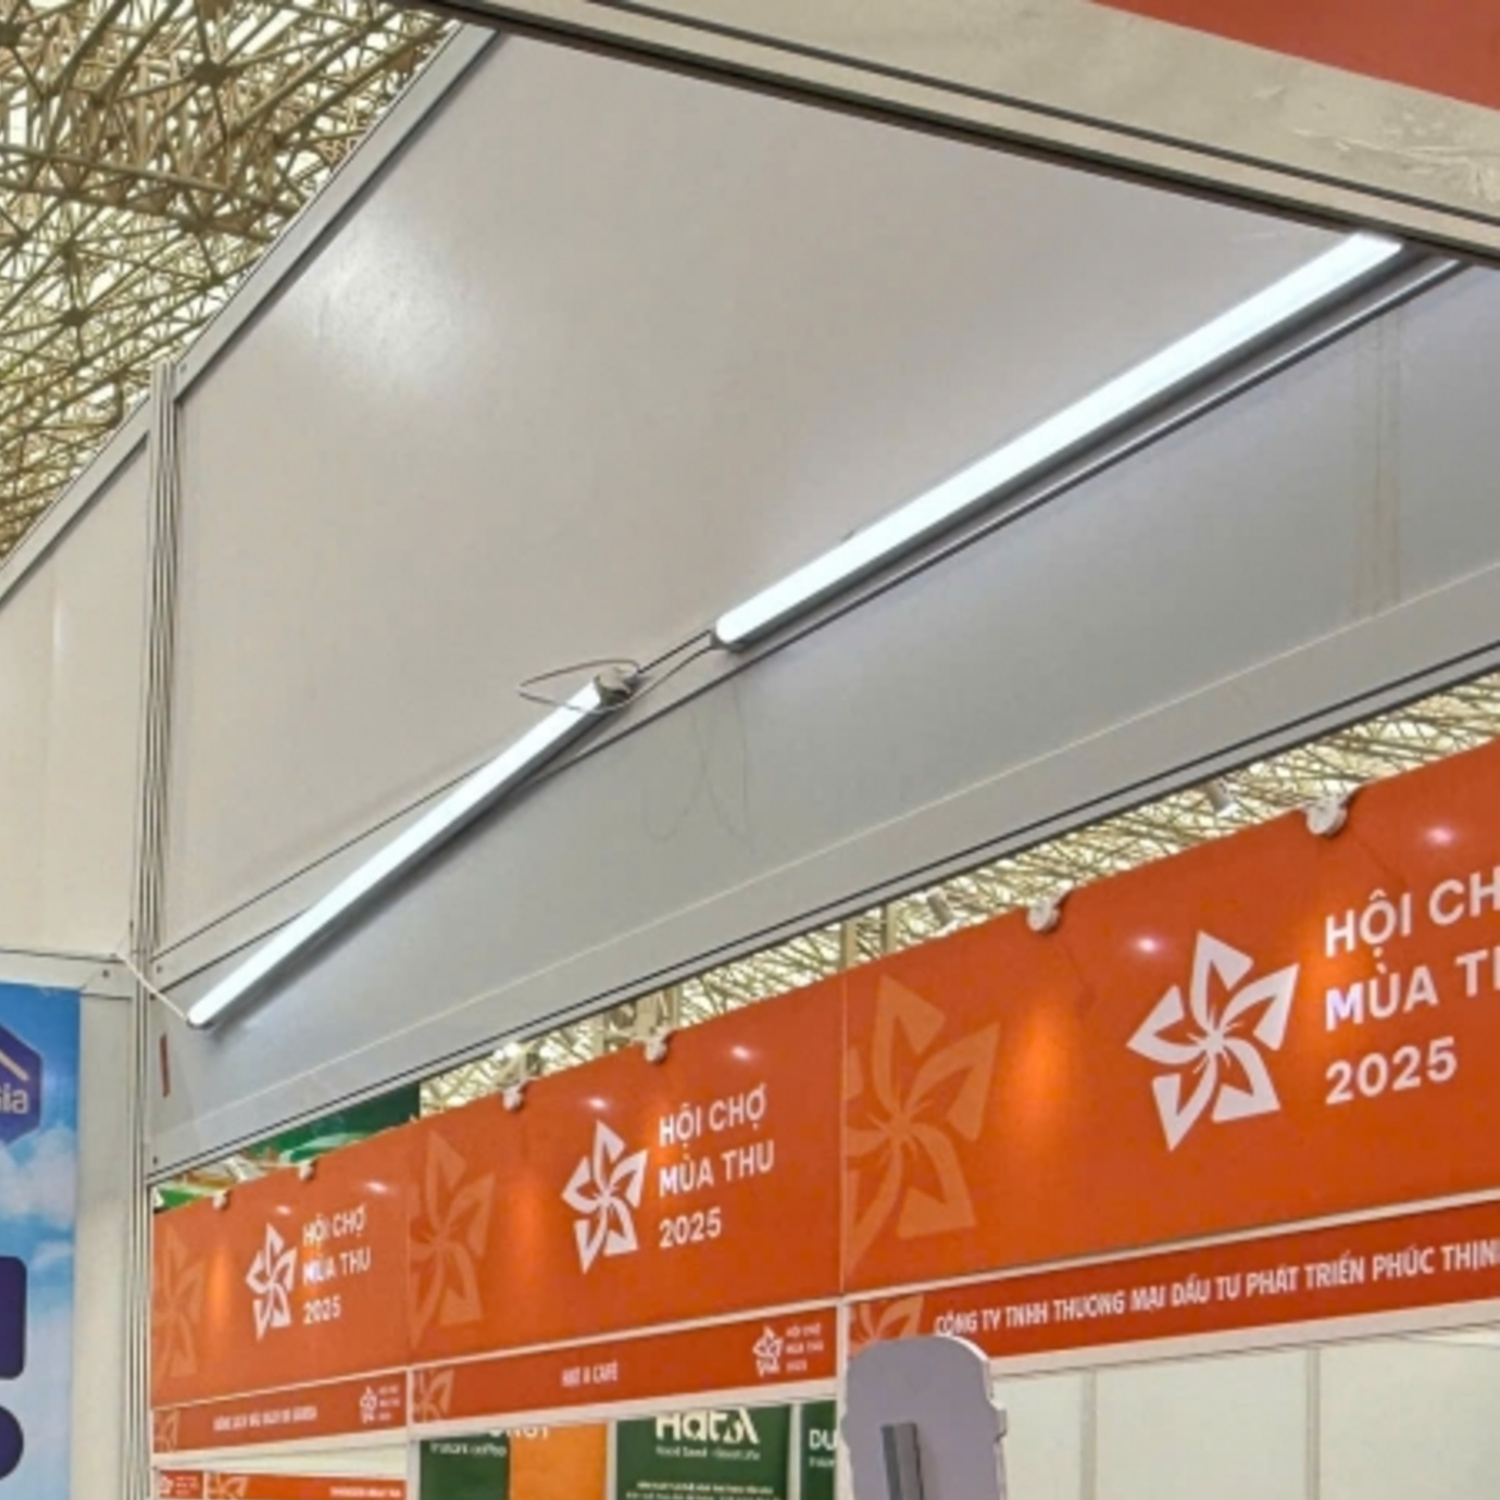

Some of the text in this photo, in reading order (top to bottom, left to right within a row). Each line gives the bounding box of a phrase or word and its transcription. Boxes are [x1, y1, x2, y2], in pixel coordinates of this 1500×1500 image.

[1324, 890, 1412, 958] HỘI
[1324, 962, 1438, 1031] MÙA
[1324, 1036, 1459, 1106] 2025
[657, 1082, 767, 1147] HỘI CHỢ
[657, 1139, 775, 1198] MÙA THU
[333, 1203, 367, 1238] CHỢ
[657, 1206, 722, 1249] 2025
[339, 1247, 372, 1276] THU
[934, 1308, 978, 1337] CÔNG
[982, 1307, 1001, 1331] TY
[1005, 1299, 1048, 1328] TNHH
[1245, 1262, 1298, 1298] PHÁT
[1372, 1244, 1435, 1282] PHÚC
[302, 1294, 342, 1326] 2025
